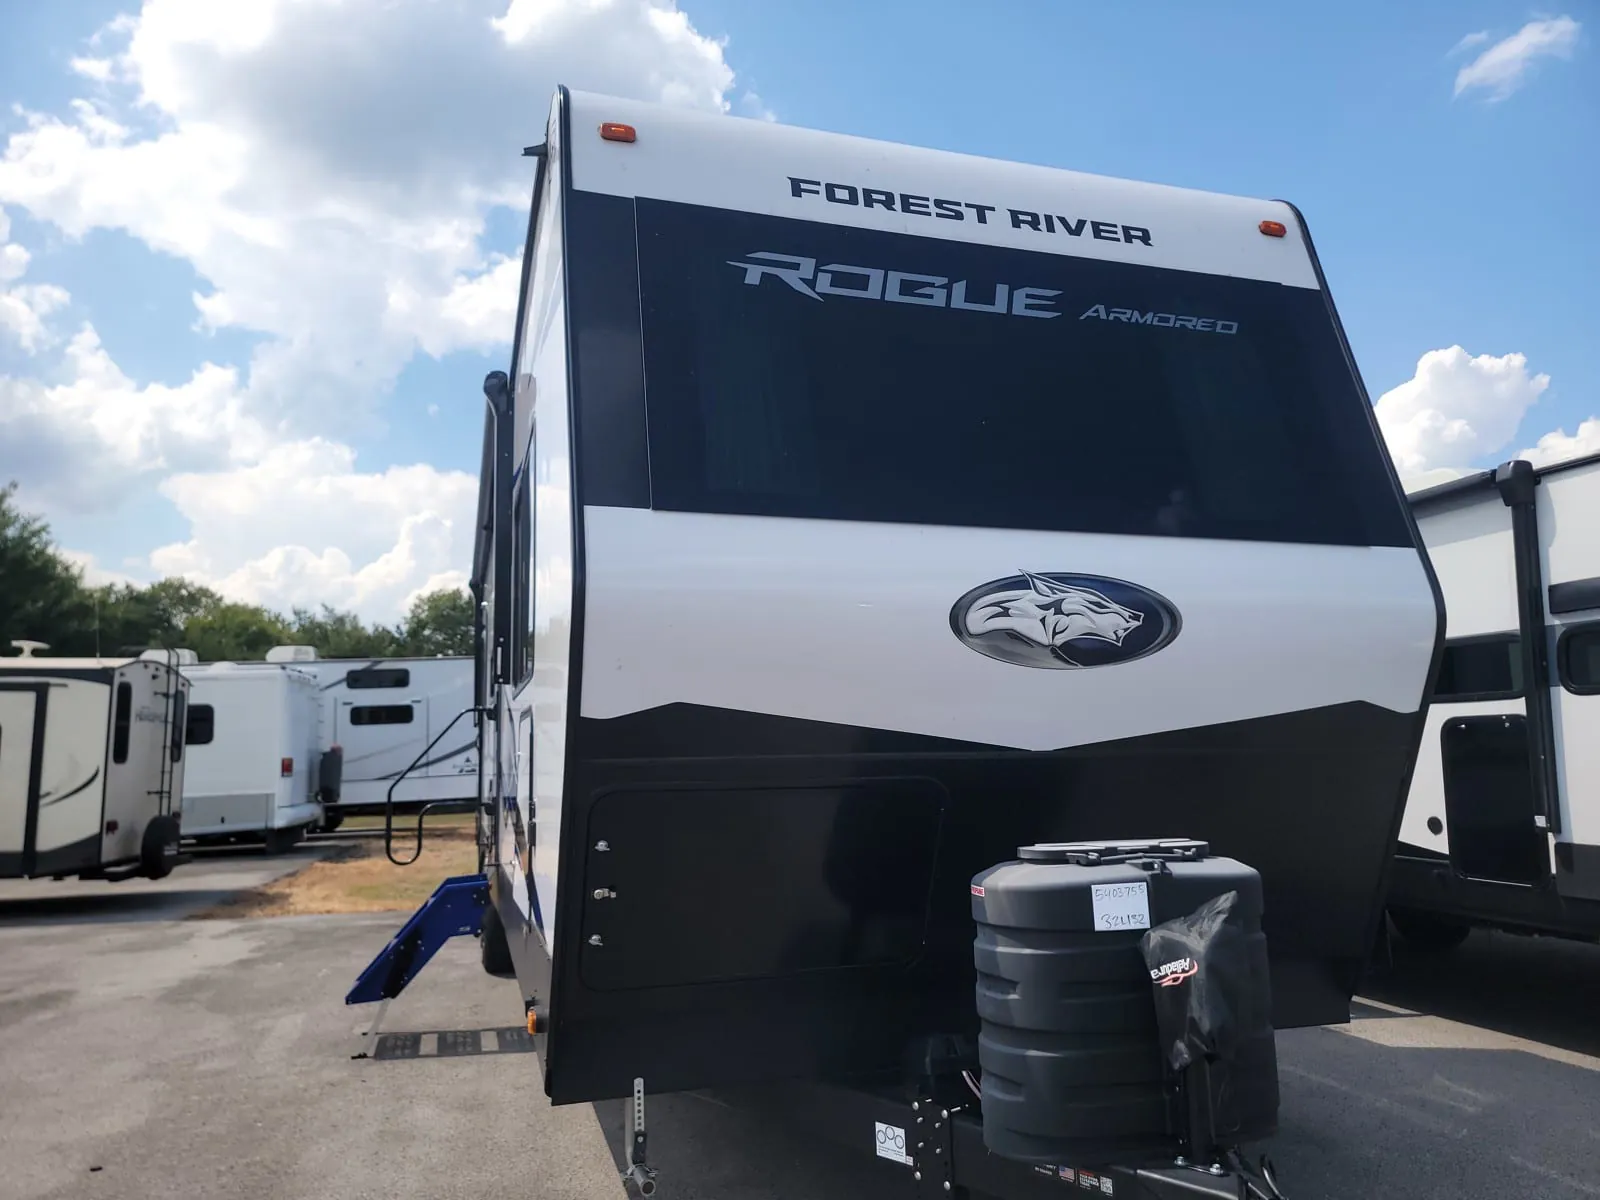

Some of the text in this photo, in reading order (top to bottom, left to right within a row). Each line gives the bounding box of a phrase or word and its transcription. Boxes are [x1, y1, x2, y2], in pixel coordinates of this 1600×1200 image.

[787, 176, 1153, 246] FOREST RIVER
[726, 251, 1063, 319] ROGUE
